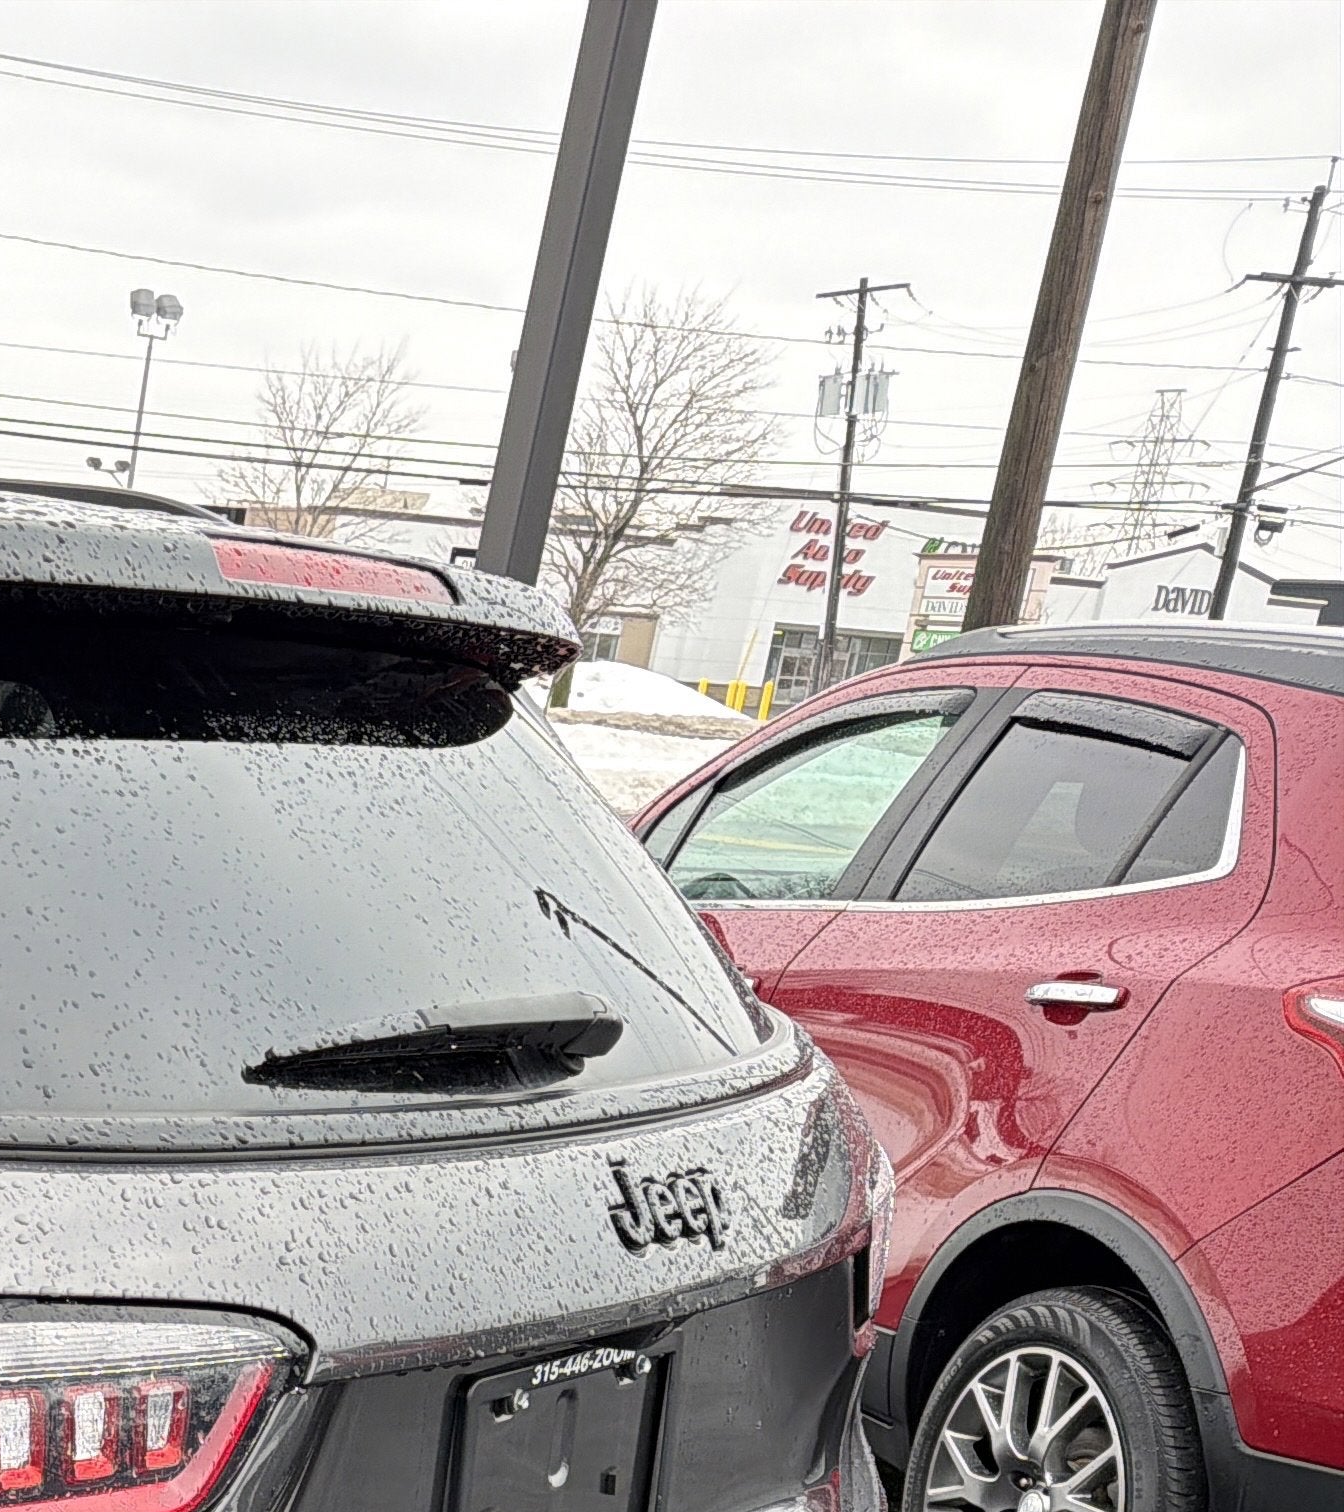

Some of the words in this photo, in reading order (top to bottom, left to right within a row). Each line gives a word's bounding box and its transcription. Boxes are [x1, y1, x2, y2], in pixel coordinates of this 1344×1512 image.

[790, 510, 890, 541] Uned
[791, 539, 866, 565] Auo
[931, 569, 976, 581] Unite
[607, 1157, 728, 1252] Jeep
